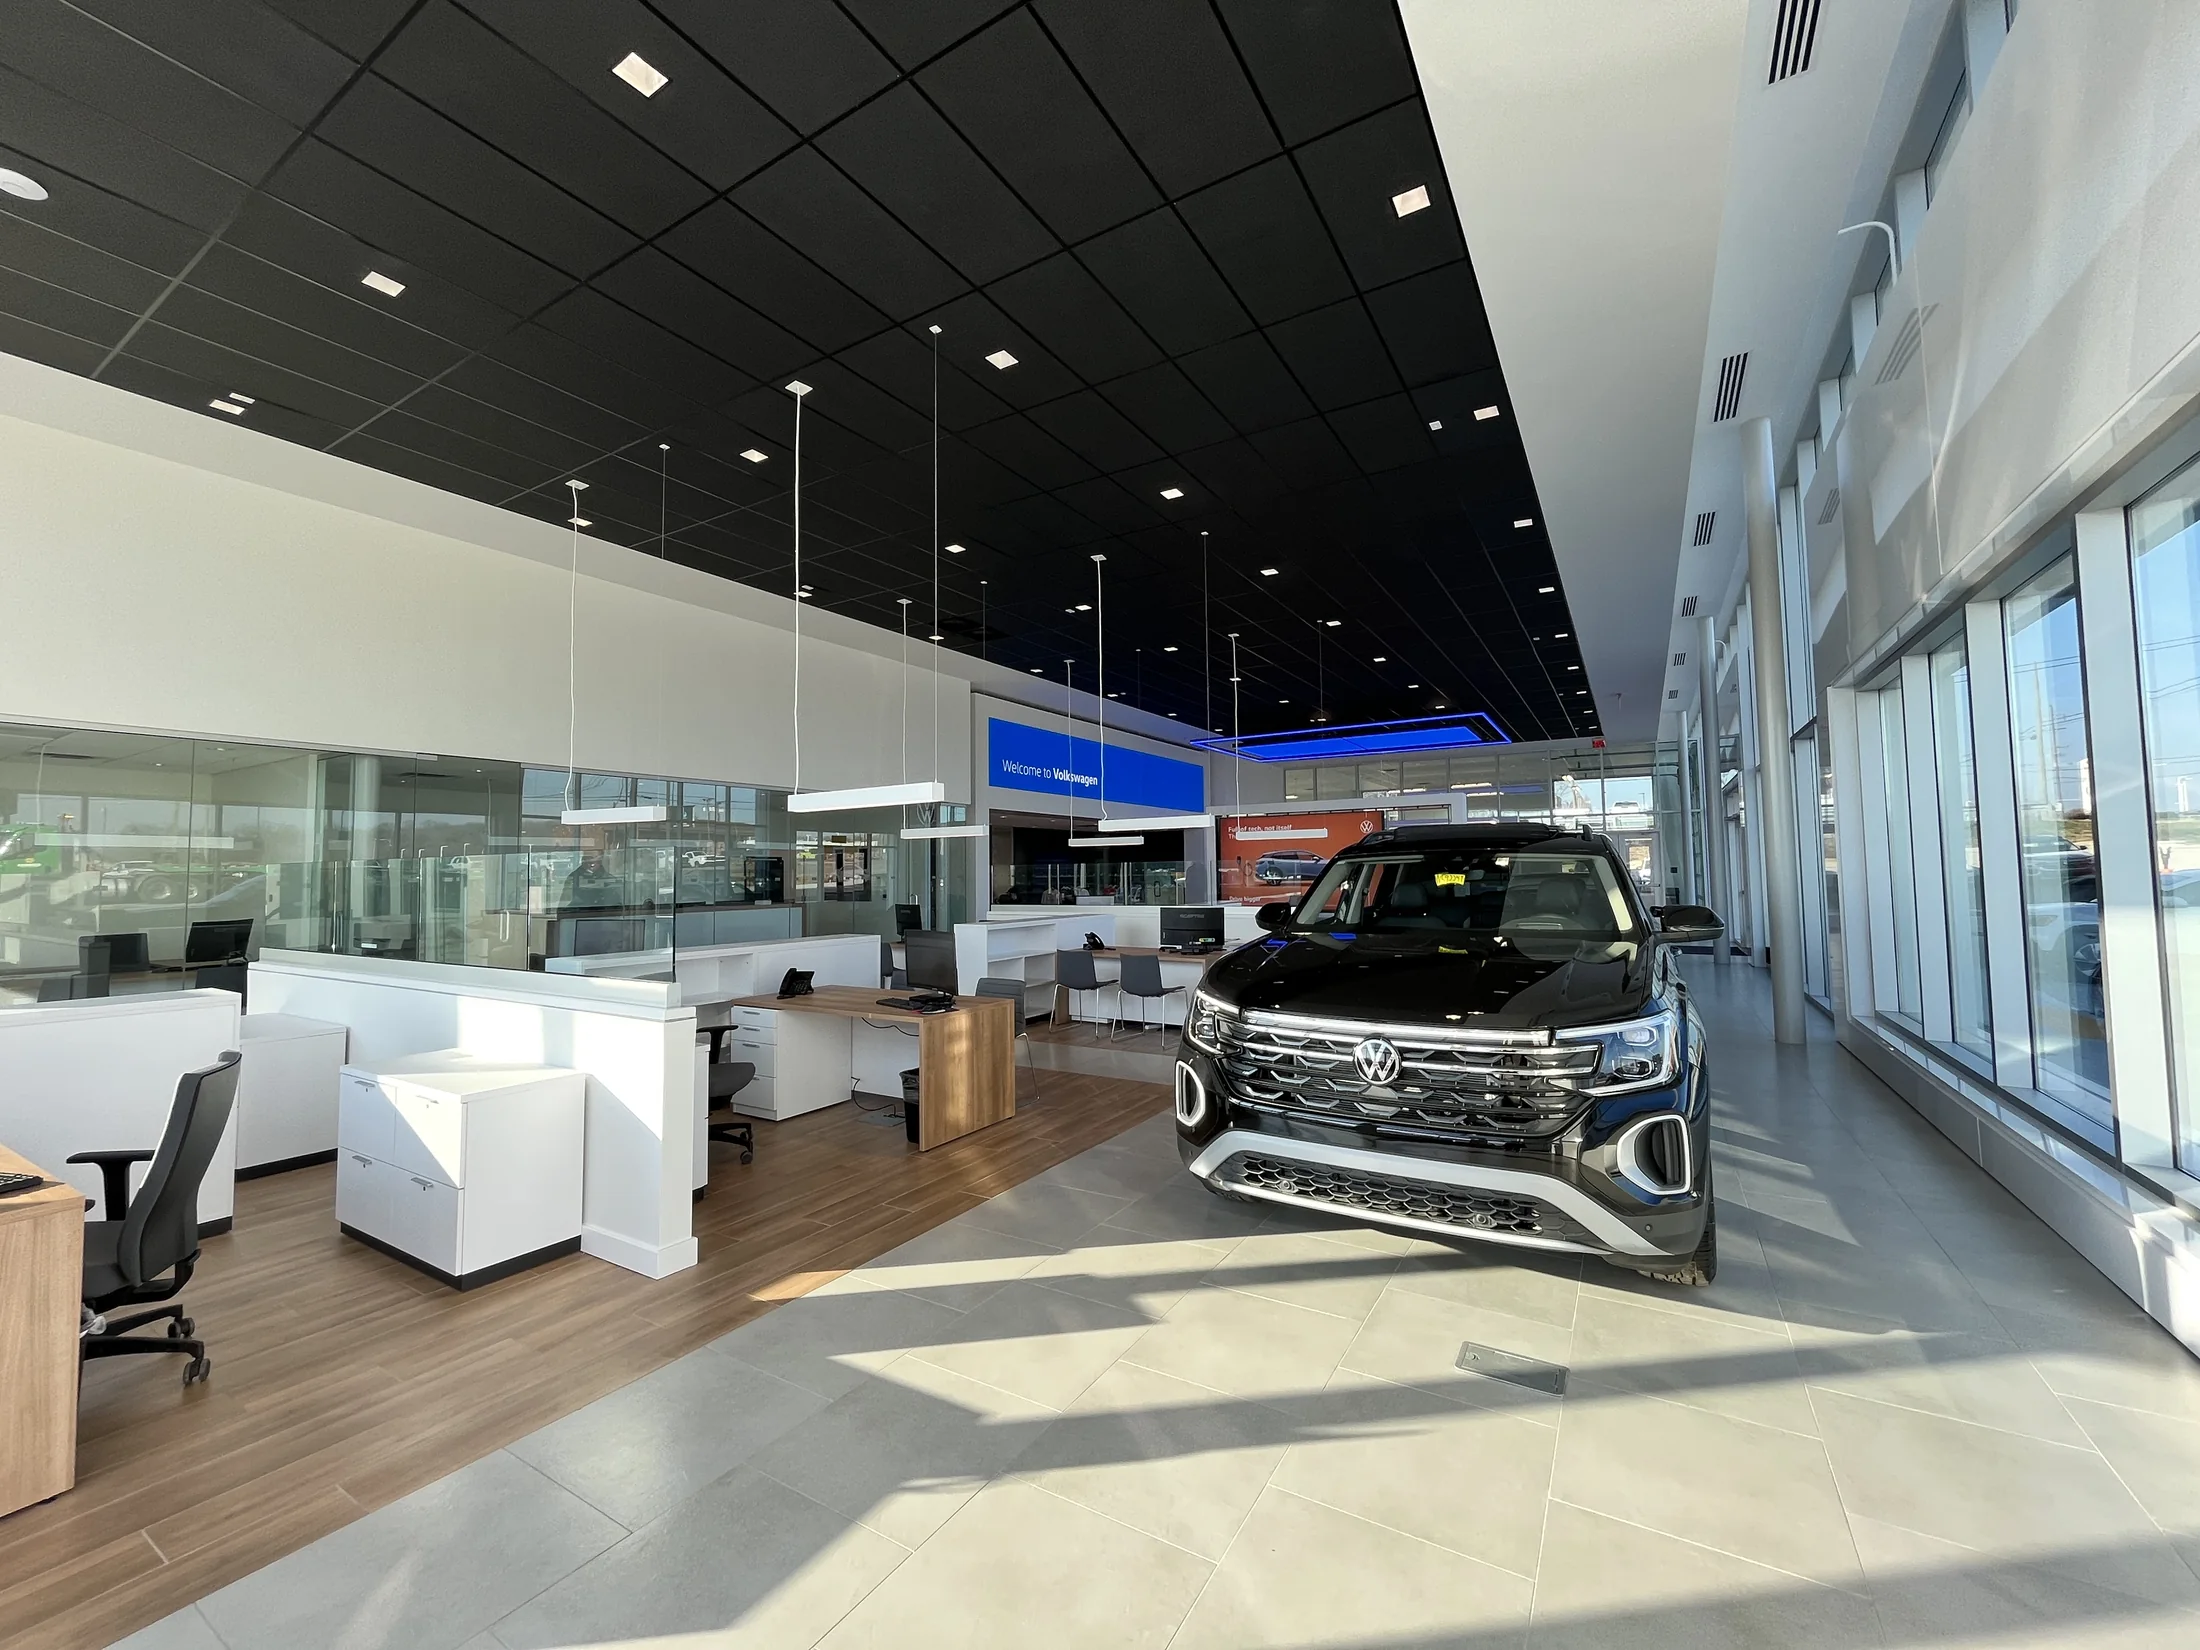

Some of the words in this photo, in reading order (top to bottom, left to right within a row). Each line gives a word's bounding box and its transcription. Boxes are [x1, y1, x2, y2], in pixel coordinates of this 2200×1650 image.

[1002, 759, 1042, 778] Welcome
[1043, 767, 1052, 779] to
[1053, 767, 1098, 787] Volkswagen
[1360, 820, 1374, 834] VW
[1354, 1038, 1401, 1085] VW
